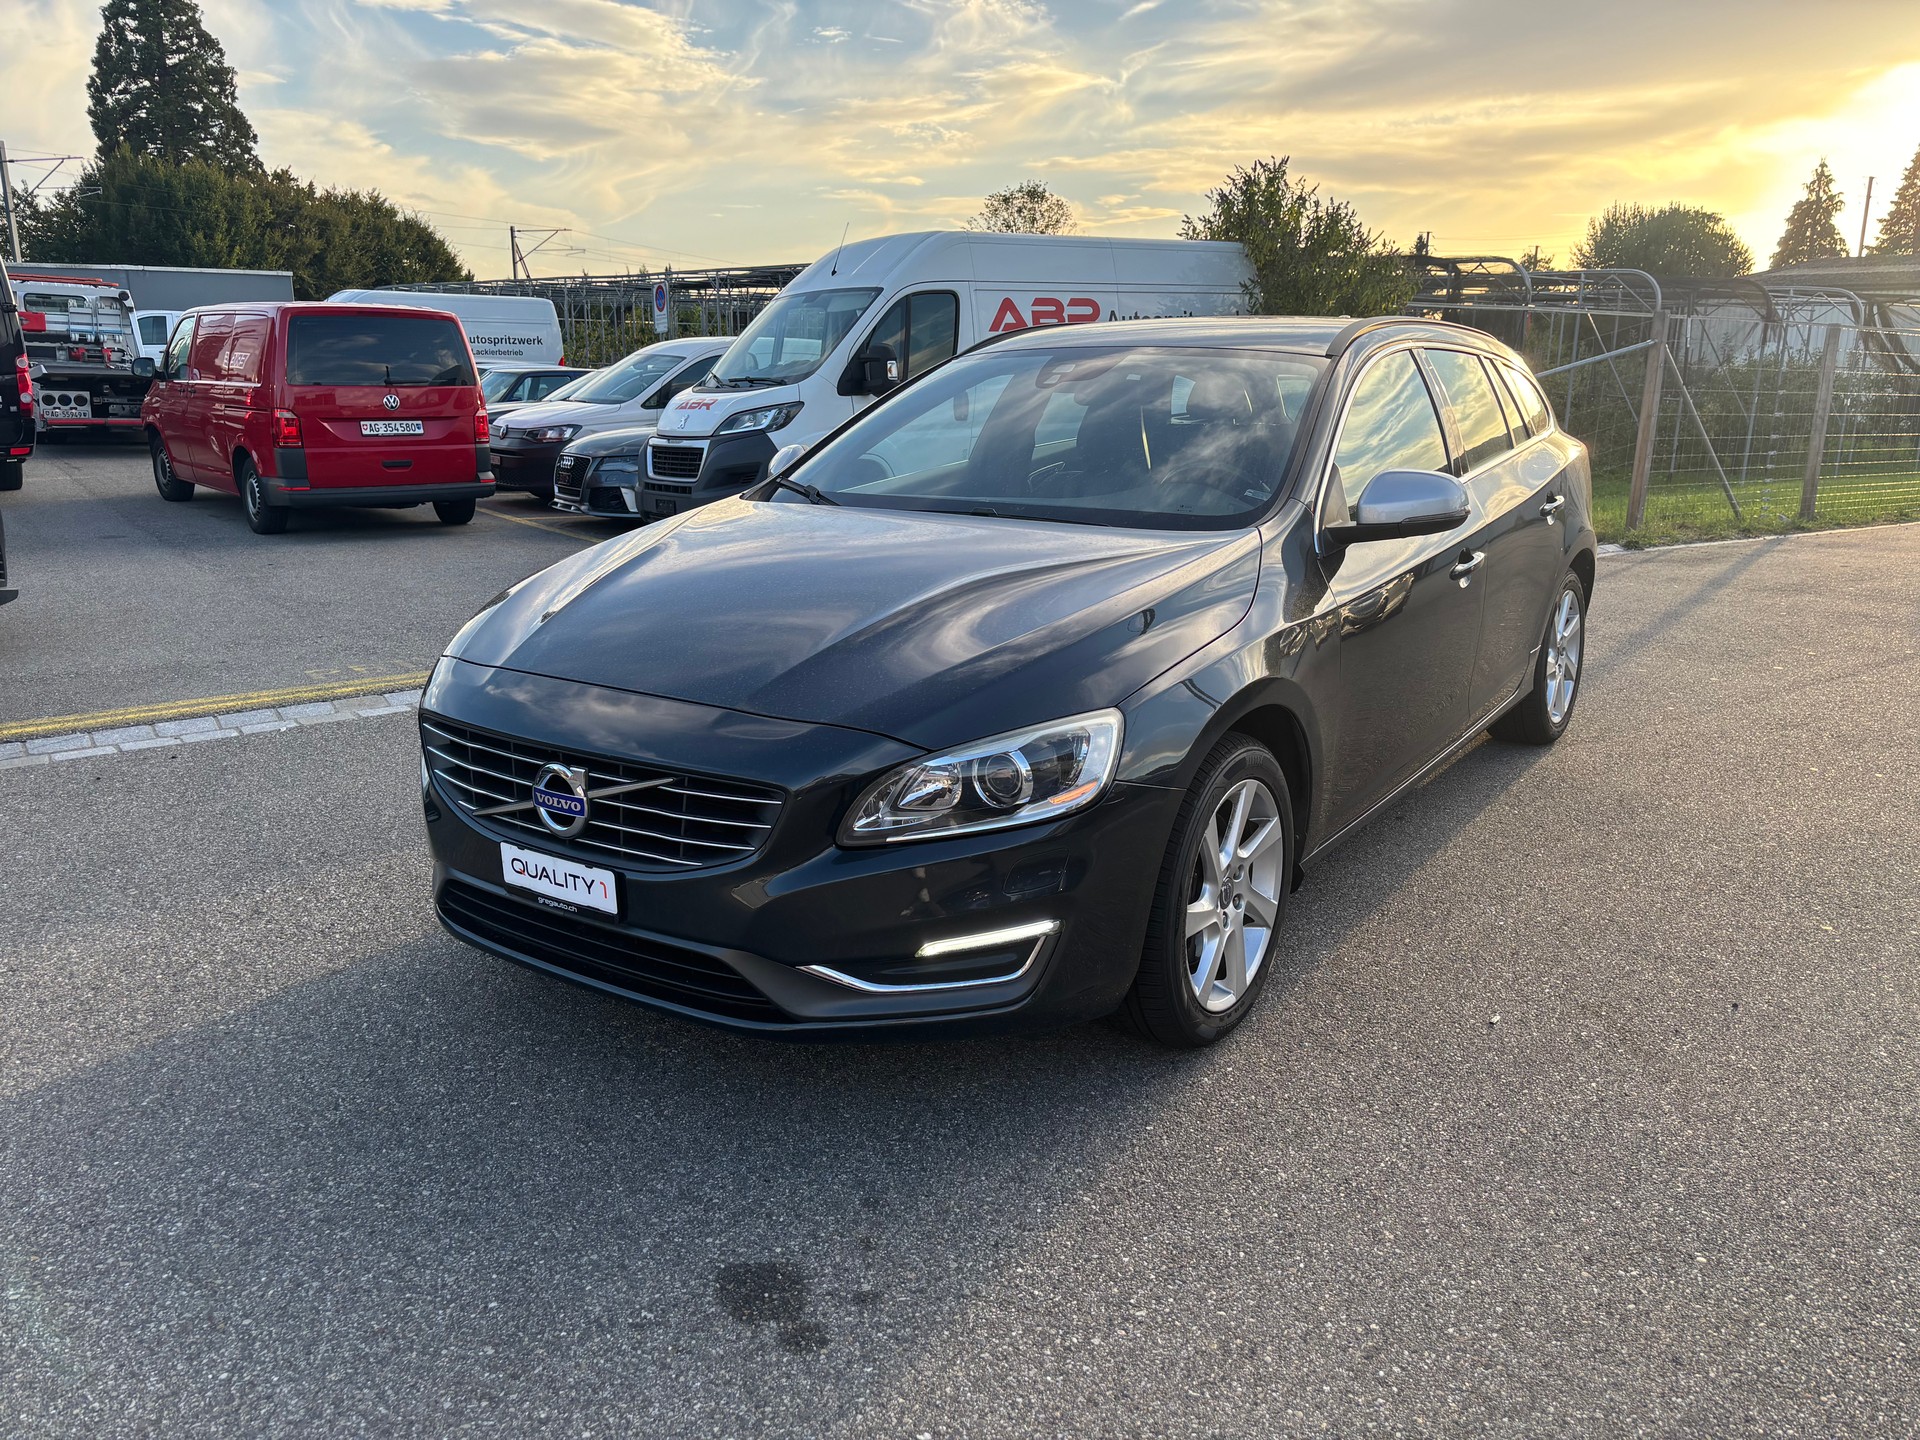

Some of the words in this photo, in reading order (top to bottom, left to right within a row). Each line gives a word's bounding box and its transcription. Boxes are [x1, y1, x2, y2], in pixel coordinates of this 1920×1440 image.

[469, 335, 543, 346] utospritzwerk
[536, 792, 581, 812] VOLVO
[511, 858, 595, 894] QUALITY
[538, 896, 578, 913] gregauto.ch
